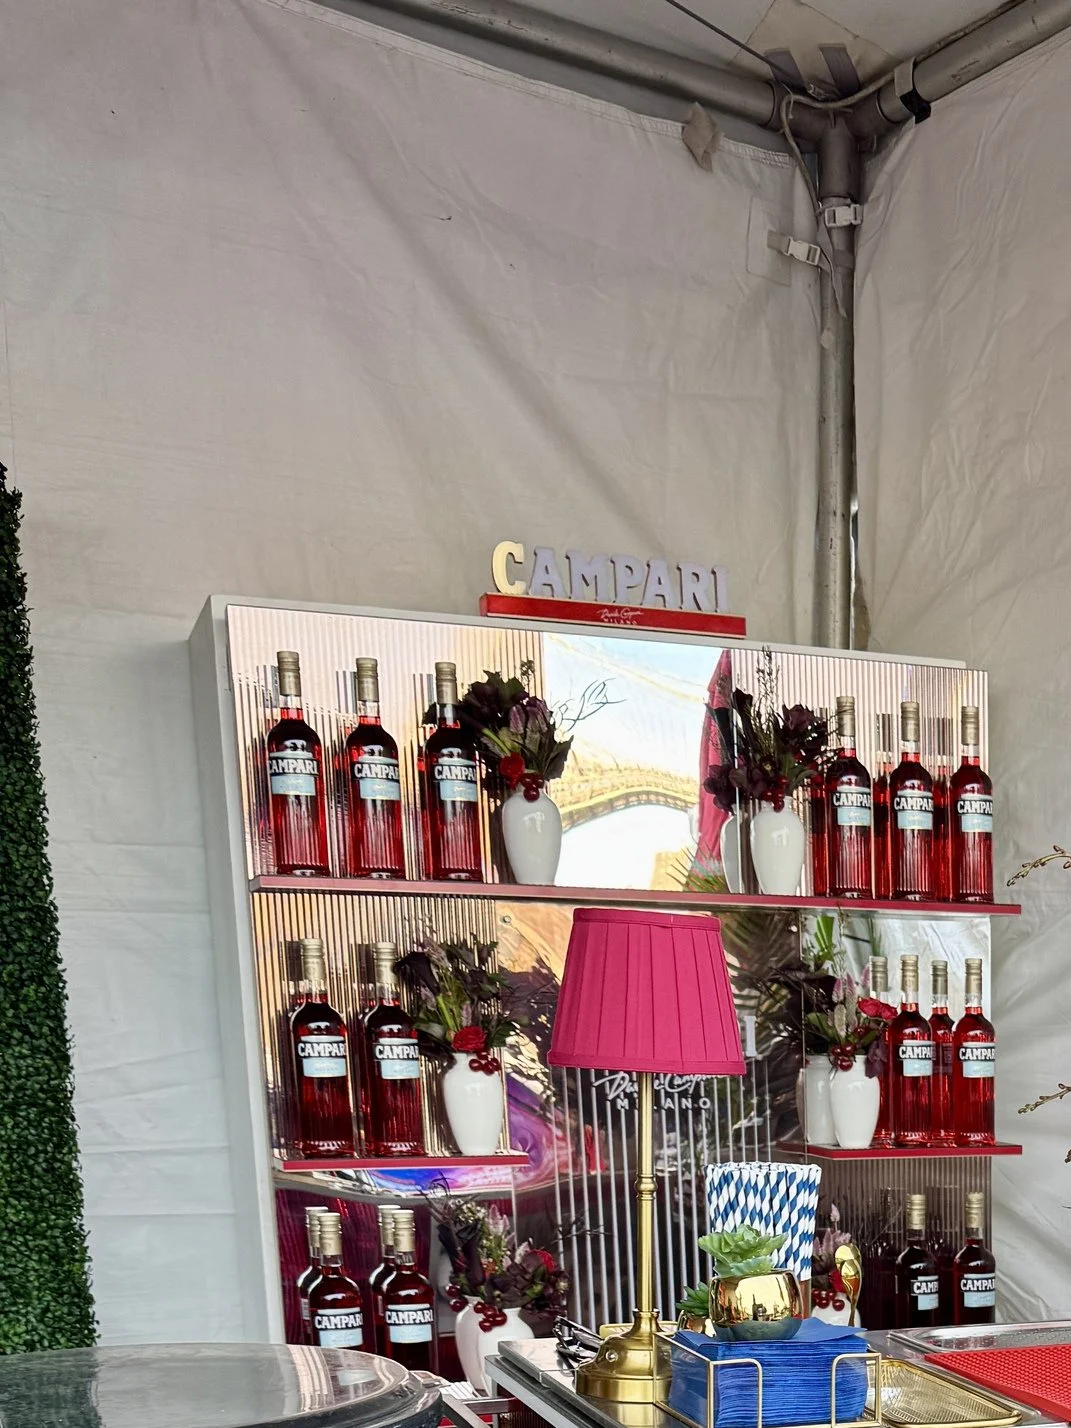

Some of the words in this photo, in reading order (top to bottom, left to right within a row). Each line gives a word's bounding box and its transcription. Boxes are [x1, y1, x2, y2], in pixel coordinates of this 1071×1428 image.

[492, 540, 729, 613] CAMPARI
[434, 765, 477, 782] CAMPA
[833, 792, 871, 808] CAMPA
[894, 797, 934, 812] CAMPAR
[957, 800, 993, 815] CAMPA
[298, 1042, 346, 1058] CAMPAR
[899, 1046, 932, 1060] CAMPA
[960, 1279, 995, 1292] CAMPA
[385, 1308, 434, 1325] CAMPARI
